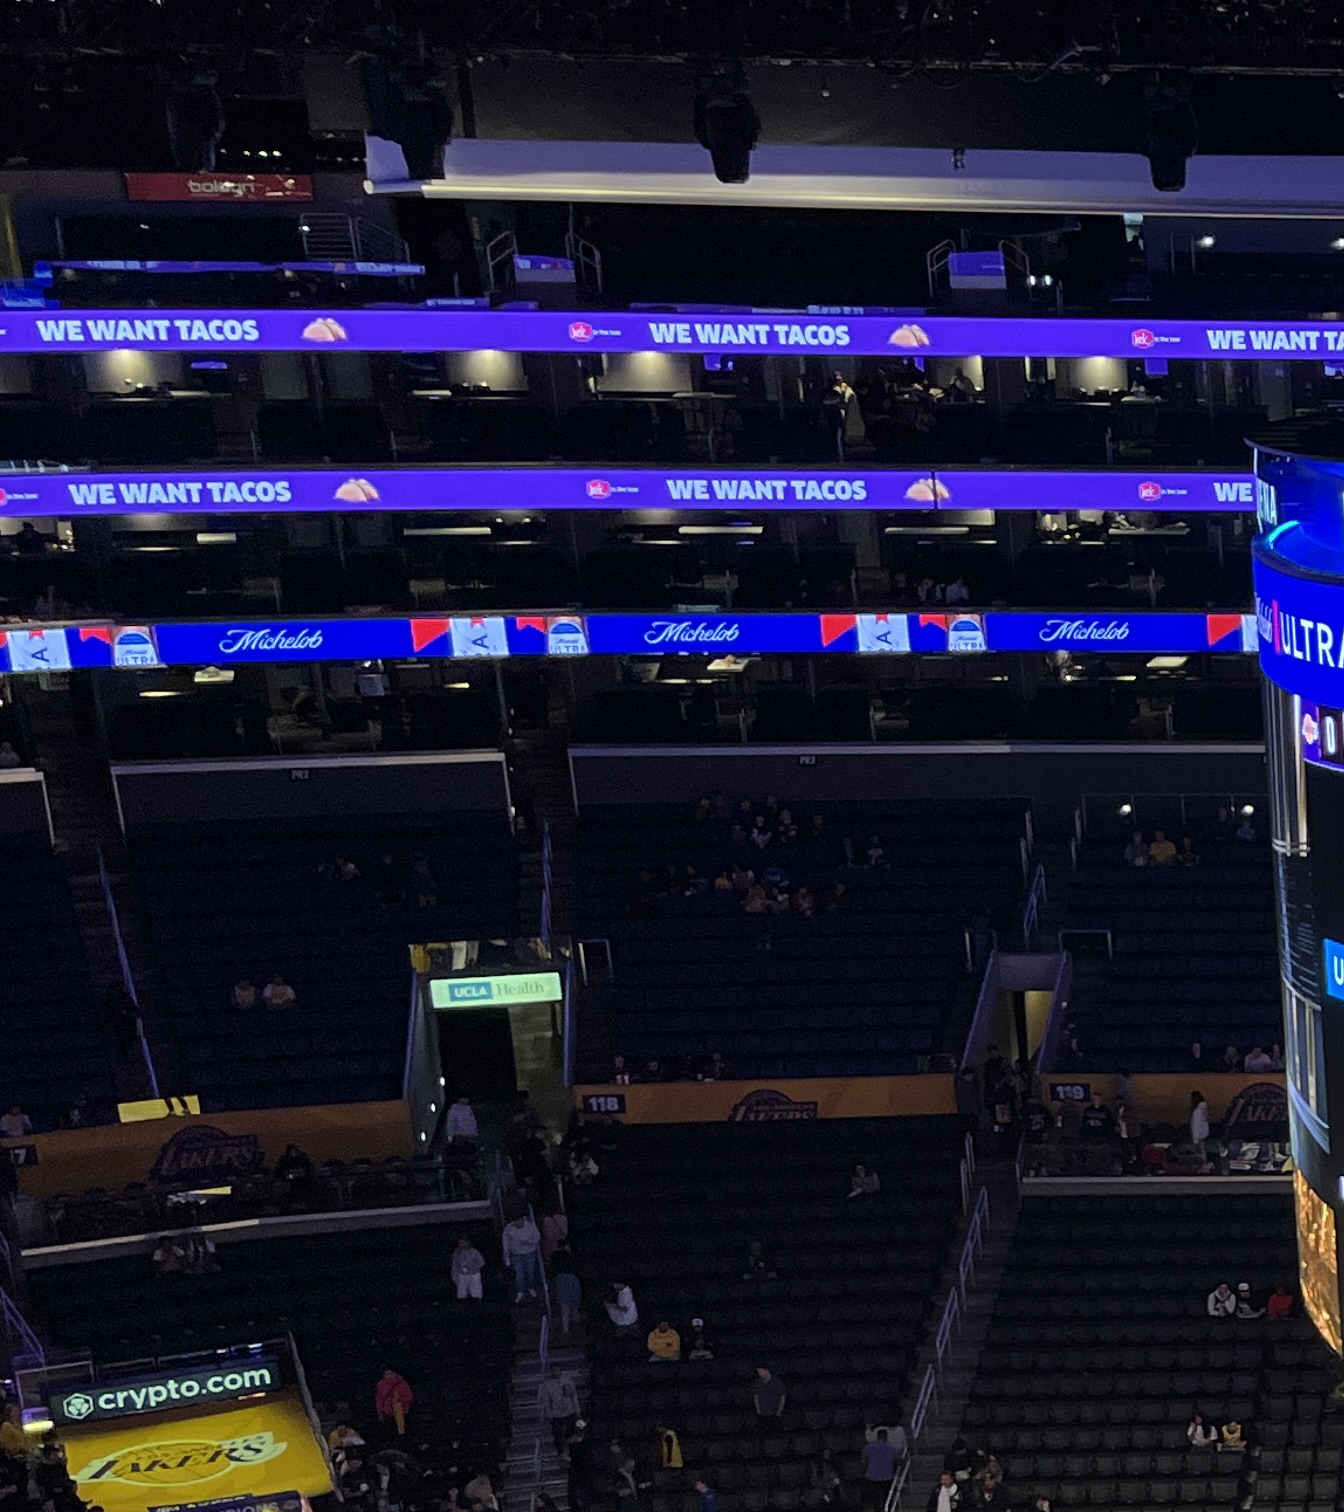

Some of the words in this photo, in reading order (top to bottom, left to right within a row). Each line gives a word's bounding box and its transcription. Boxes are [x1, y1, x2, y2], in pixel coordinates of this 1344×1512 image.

[36, 320, 85, 342] WE
[86, 320, 170, 342] WANT
[173, 319, 260, 341] TACOS
[649, 322, 692, 343] WE
[694, 324, 770, 345] WANT
[774, 325, 850, 346] TACOS
[1207, 329, 1246, 350] WE
[1249, 331, 1321, 351] WANT
[68, 483, 116, 505] WE
[118, 482, 203, 504] WANT
[206, 481, 292, 503] TACOS
[667, 480, 710, 500] WE
[712, 480, 787, 501] WANT
[790, 479, 867, 501] TACOS
[1214, 483, 1253, 502] WE
[219, 628, 323, 654] Michelob
[644, 621, 740, 645] Michelob
[1040, 619, 1130, 642] Michelob
[1325, 715, 1337, 754] 0
[454, 986, 488, 998] UCLA
[495, 981, 545, 997] Health
[588, 1096, 619, 1113] 118
[98, 1367, 271, 1410] crypto.com
